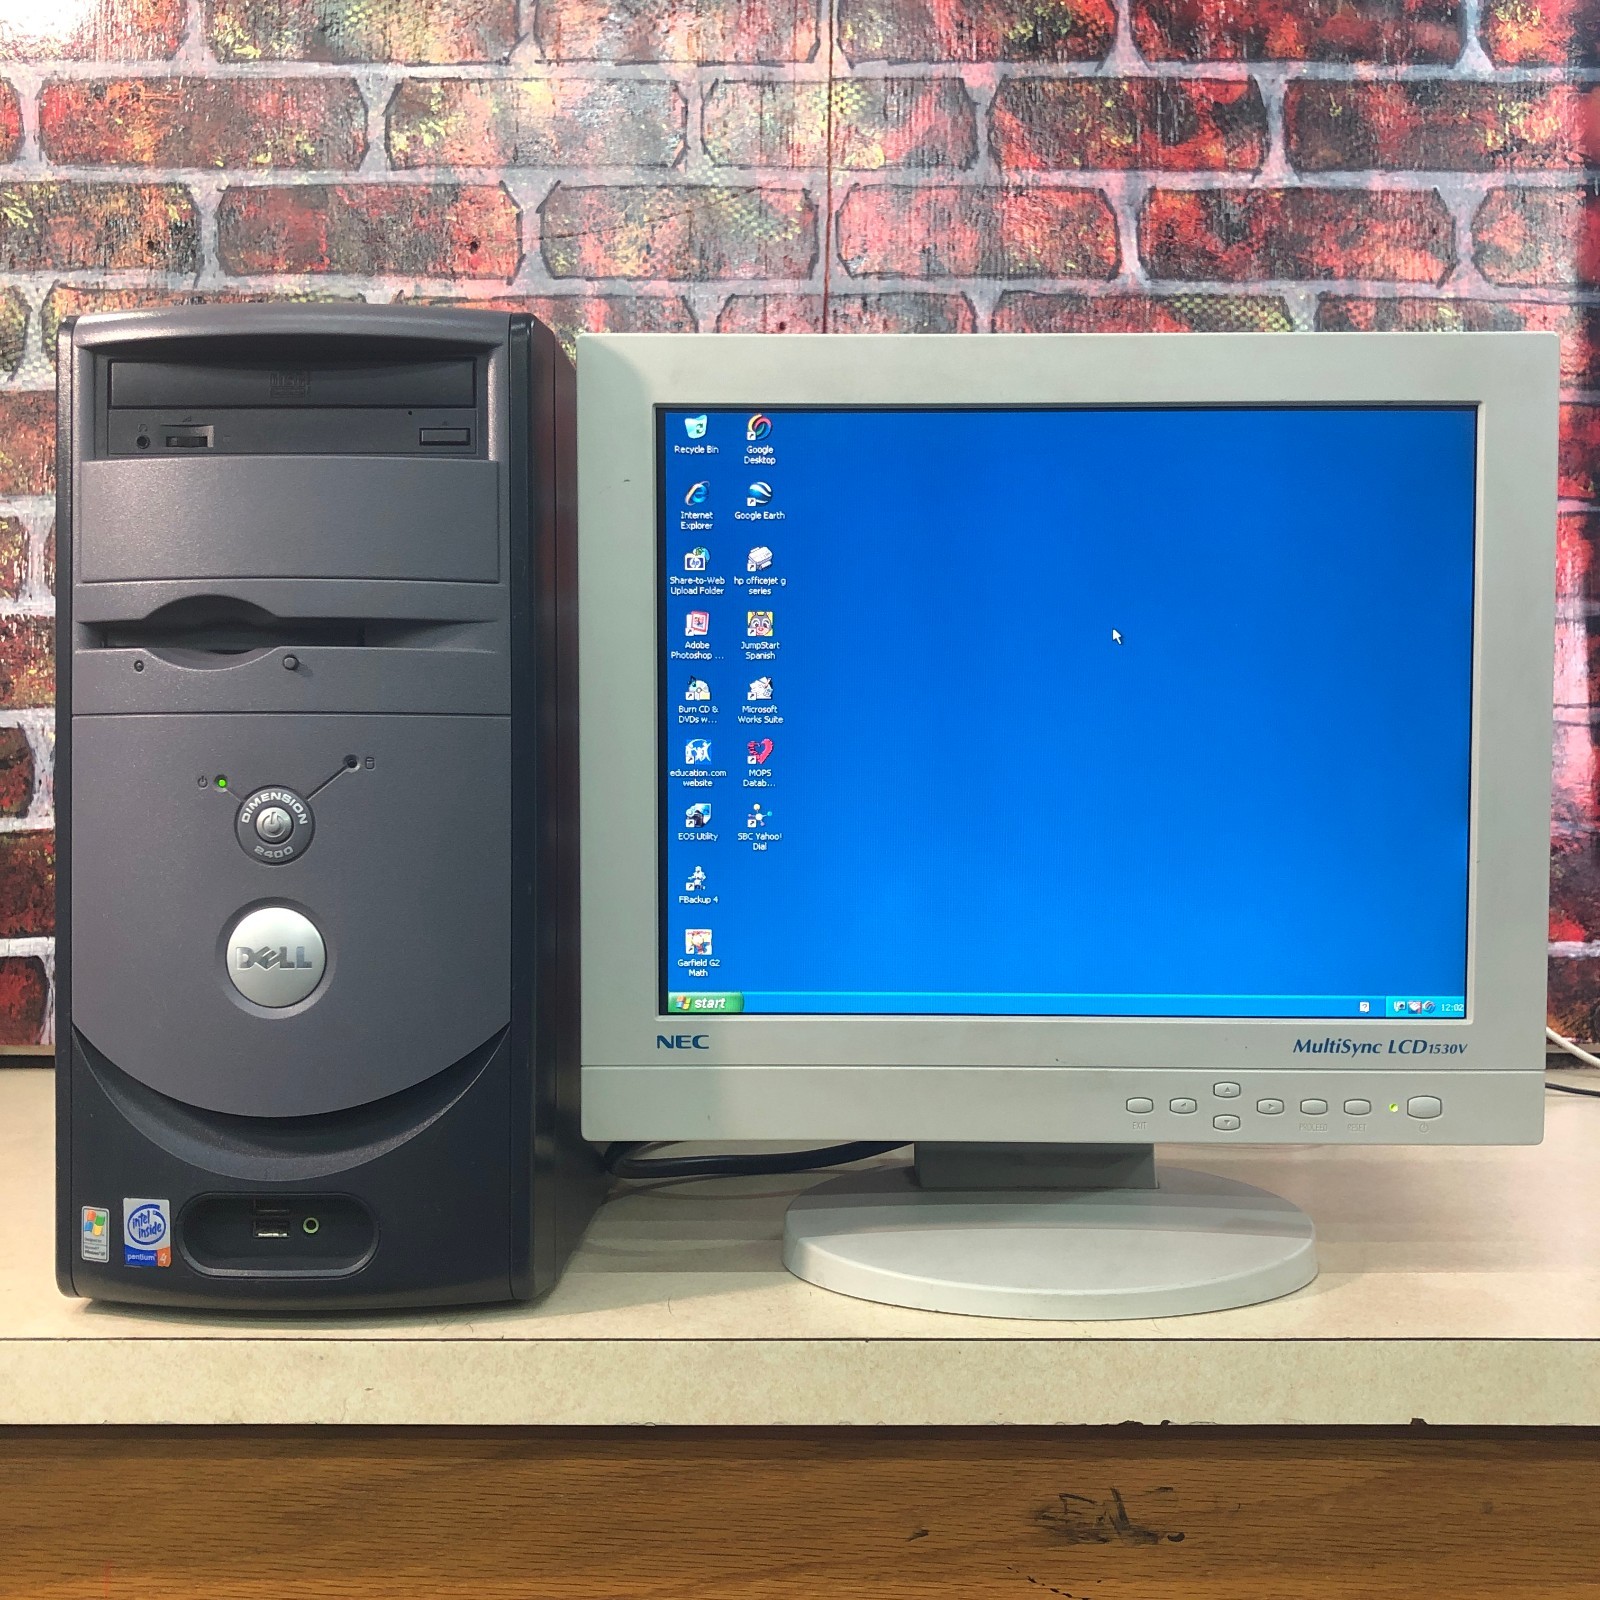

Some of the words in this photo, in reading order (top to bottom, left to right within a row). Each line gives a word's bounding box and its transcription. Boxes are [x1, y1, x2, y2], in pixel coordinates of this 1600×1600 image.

[674, 445, 705, 454] Recycle
[706, 445, 719, 454] Bin
[746, 445, 774, 455] Google
[743, 456, 776, 465] Desktop
[680, 511, 713, 520] Internet
[734, 511, 762, 521] Google
[763, 511, 785, 520] Earth
[680, 521, 713, 531] Explorer
[669, 576, 725, 585] Share-to-Web
[733, 576, 744, 586] hp
[745, 576, 778, 586] officejet
[780, 578, 787, 586] g
[670, 587, 698, 596] Upload
[699, 587, 724, 595] Folder
[684, 641, 710, 649] Adobe
[740, 641, 780, 650] JumpStart
[670, 651, 713, 660] Photoshop
[745, 651, 776, 660] Spanish
[678, 705, 697, 713] Burn
[698, 705, 710, 713] CD
[712, 705, 719, 713] &
[741, 705, 778, 713] Microsoft
[678, 716, 700, 724] DVDs
[737, 716, 762, 724] Works
[763, 716, 784, 724] Suite
[669, 769, 727, 777] education.com
[748, 769, 772, 777] MOPS
[682, 779, 713, 787] website
[241, 792, 308, 825] DIMENSION
[678, 833, 695, 841] EOS
[696, 832, 718, 842] Utility
[737, 833, 754, 841] SBC
[755, 832, 782, 841] Yahoo!
[752, 842, 767, 851] Dial
[254, 845, 294, 859] 2400
[678, 896, 711, 905] FBackup
[713, 896, 719, 904] 4
[236, 946, 312, 971] DELL
[677, 958, 708, 967] Garfield
[709, 959, 720, 967] G2
[688, 969, 708, 977] Math
[694, 997, 726, 1009] start
[1441, 1003, 1464, 1012] 12:02
[656, 1034, 710, 1050] NEC
[1293, 1038, 1383, 1058] MultiSync
[1132, 1121, 1148, 1130] EXIT
[132, 1210, 151, 1228] intel
[138, 1221, 162, 1239] inside
[127, 1253, 155, 1262] pentium
[159, 1252, 168, 1264] 4
